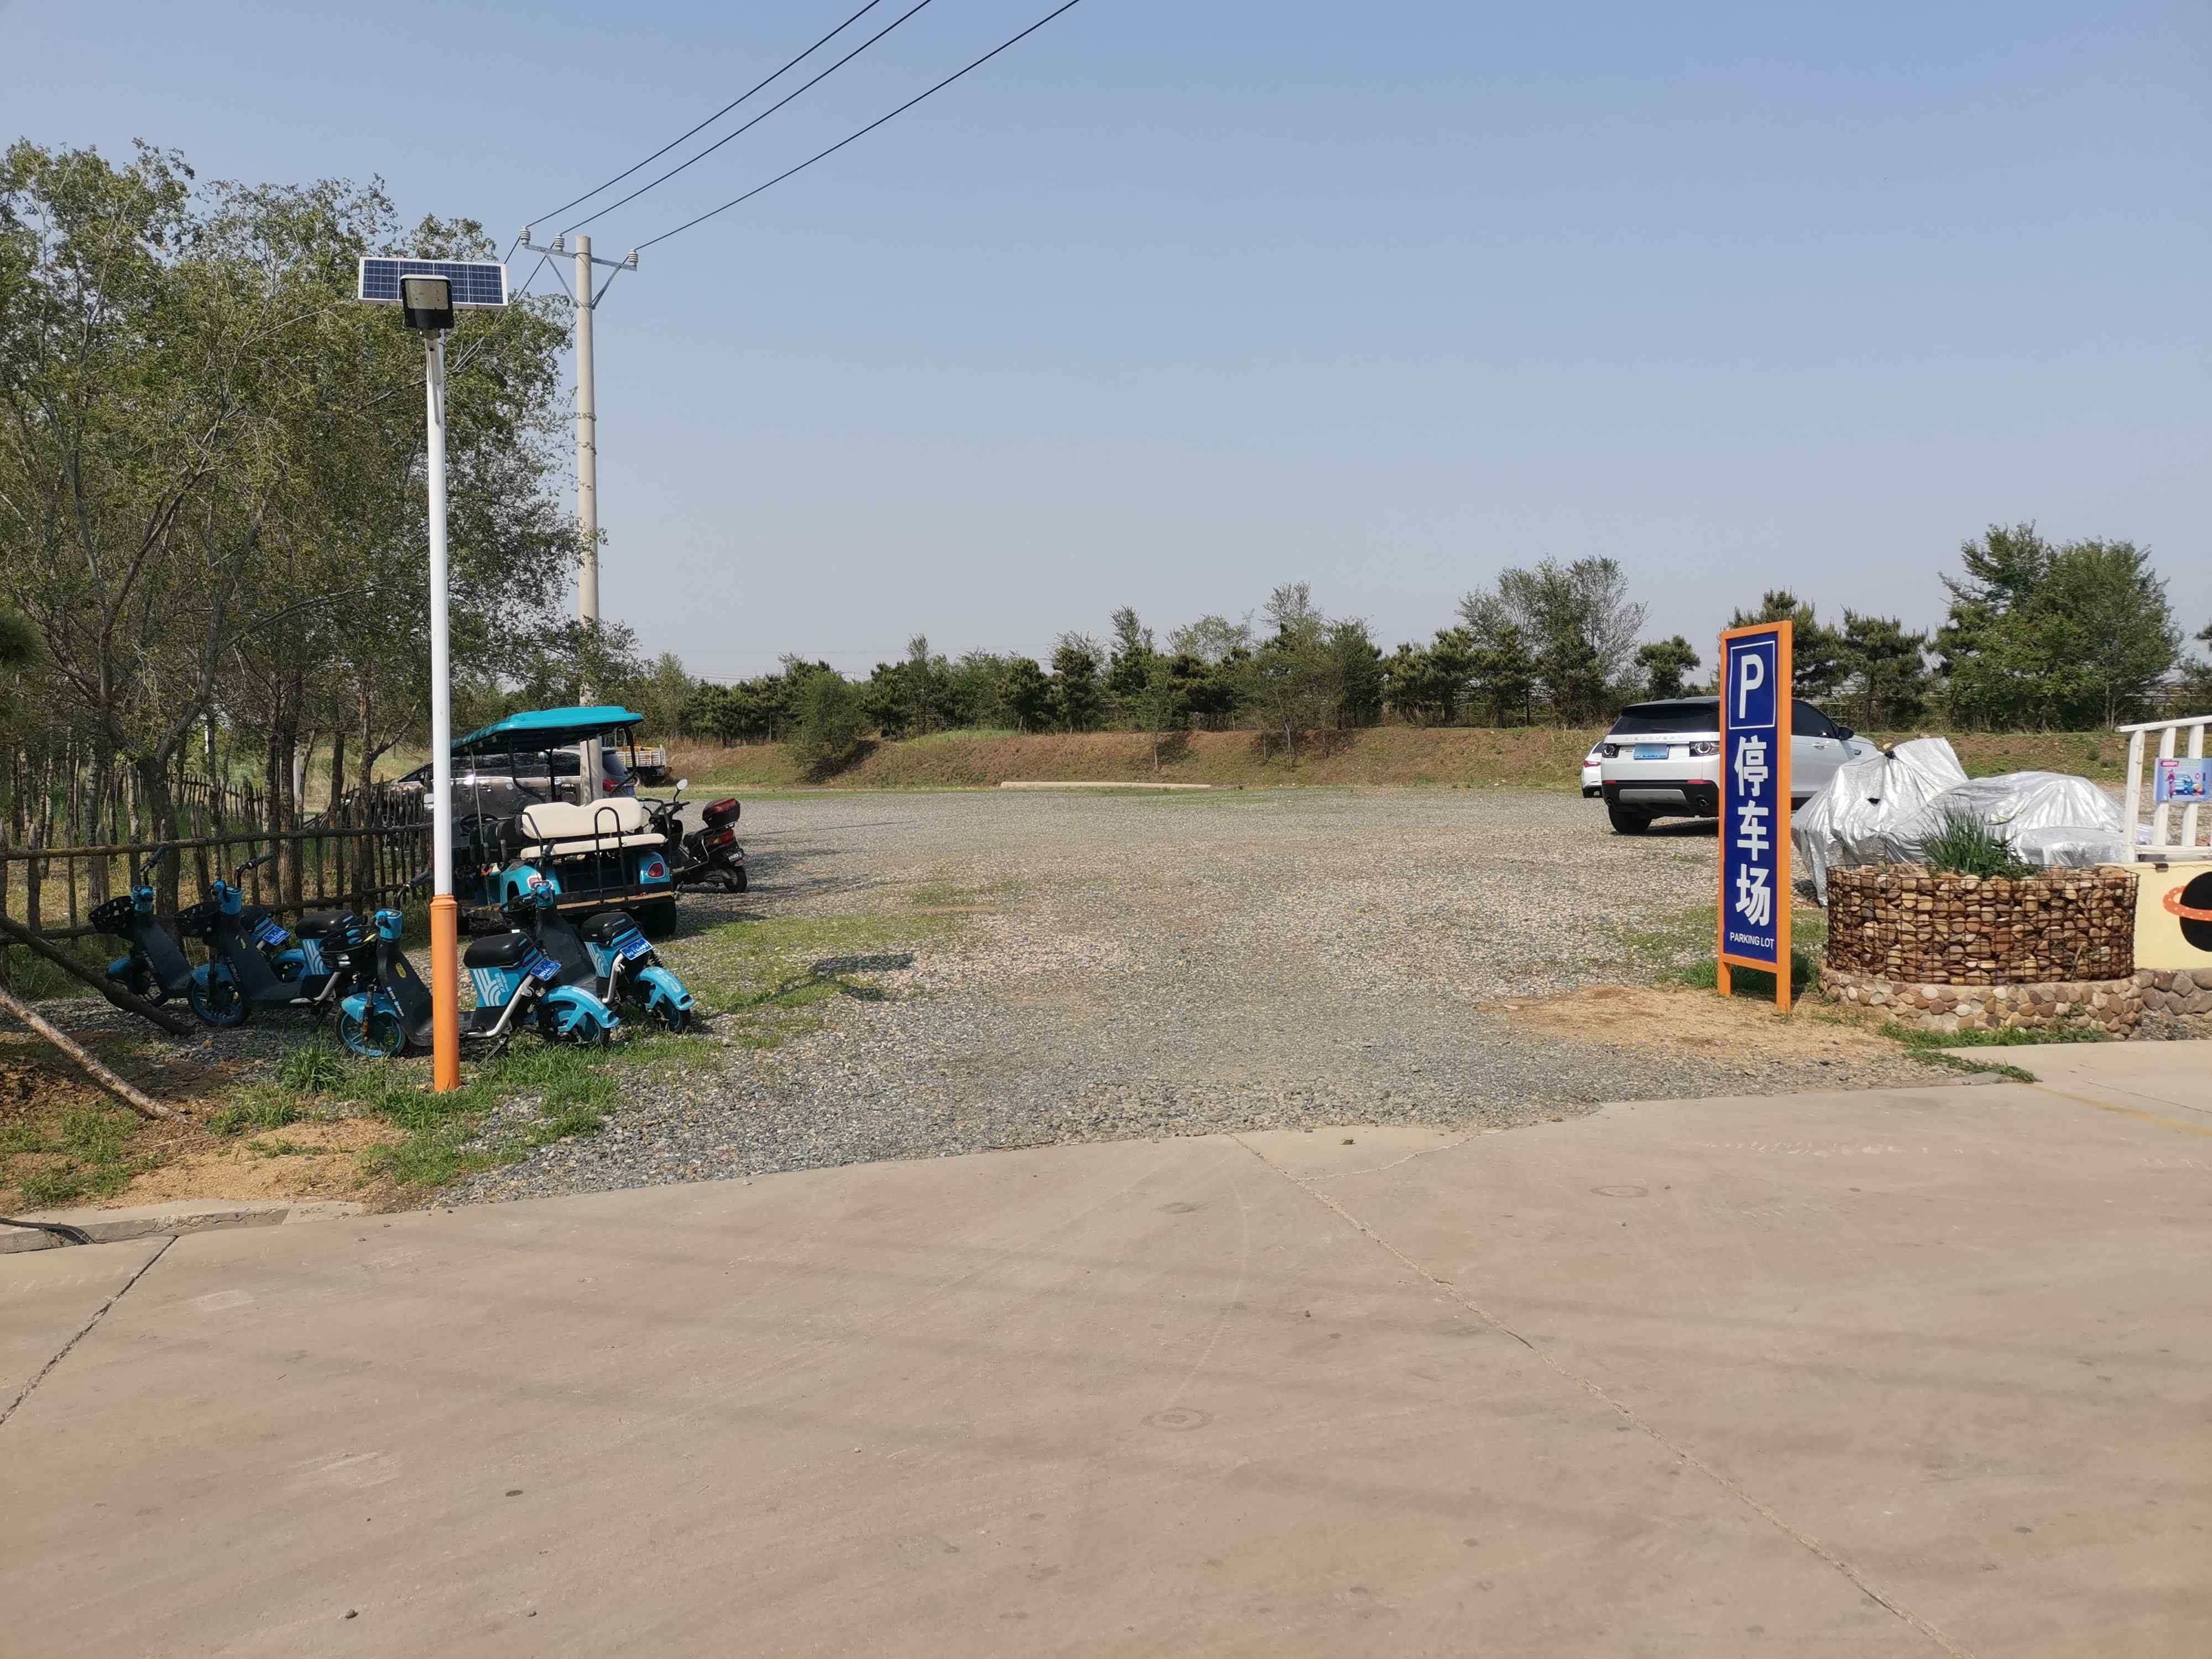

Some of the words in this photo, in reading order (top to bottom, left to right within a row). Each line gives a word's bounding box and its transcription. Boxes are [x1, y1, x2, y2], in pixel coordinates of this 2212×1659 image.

[1739, 654, 1764, 719] P
[1734, 735, 1771, 926] 停车场
[1730, 932, 1760, 946] PARKING
[1760, 937, 1775, 950] LOT
